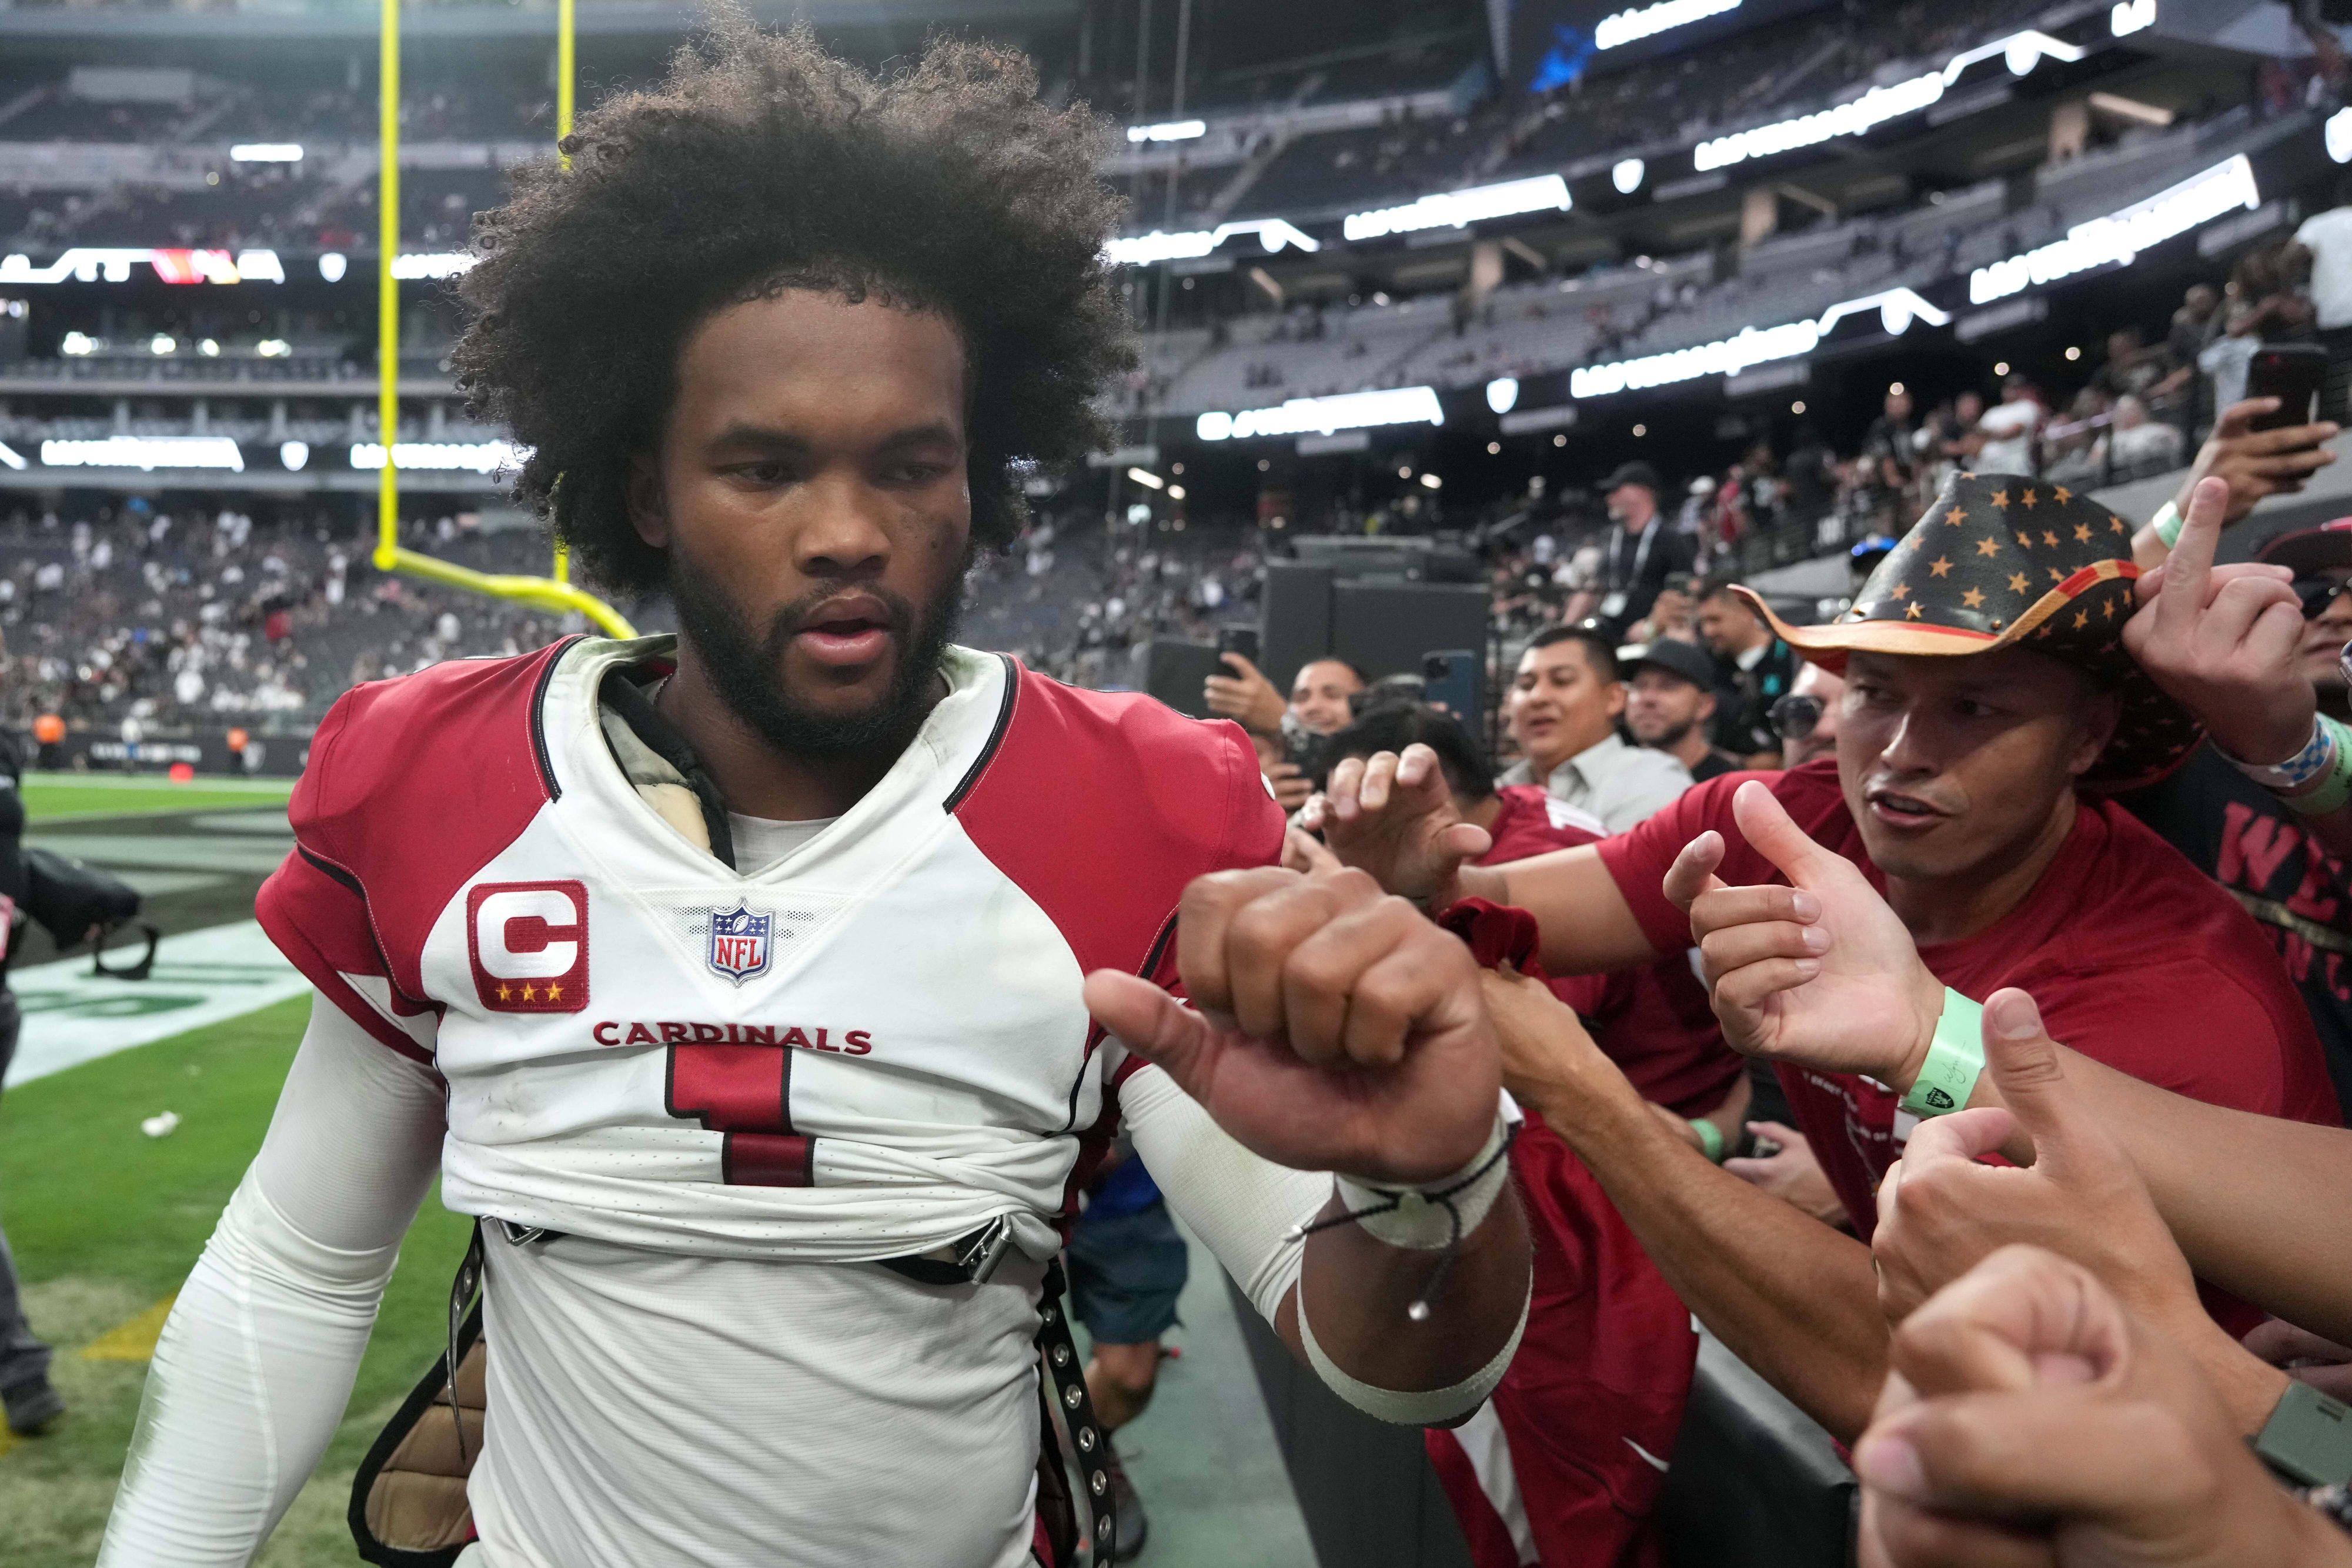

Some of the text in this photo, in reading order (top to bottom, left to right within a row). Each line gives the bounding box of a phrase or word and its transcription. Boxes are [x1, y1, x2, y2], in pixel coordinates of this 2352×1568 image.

[476, 890, 578, 979] C
[716, 937, 761, 971] NFL
[593, 1021, 872, 1055] CARDINALS
[664, 1041, 816, 1188] 1
